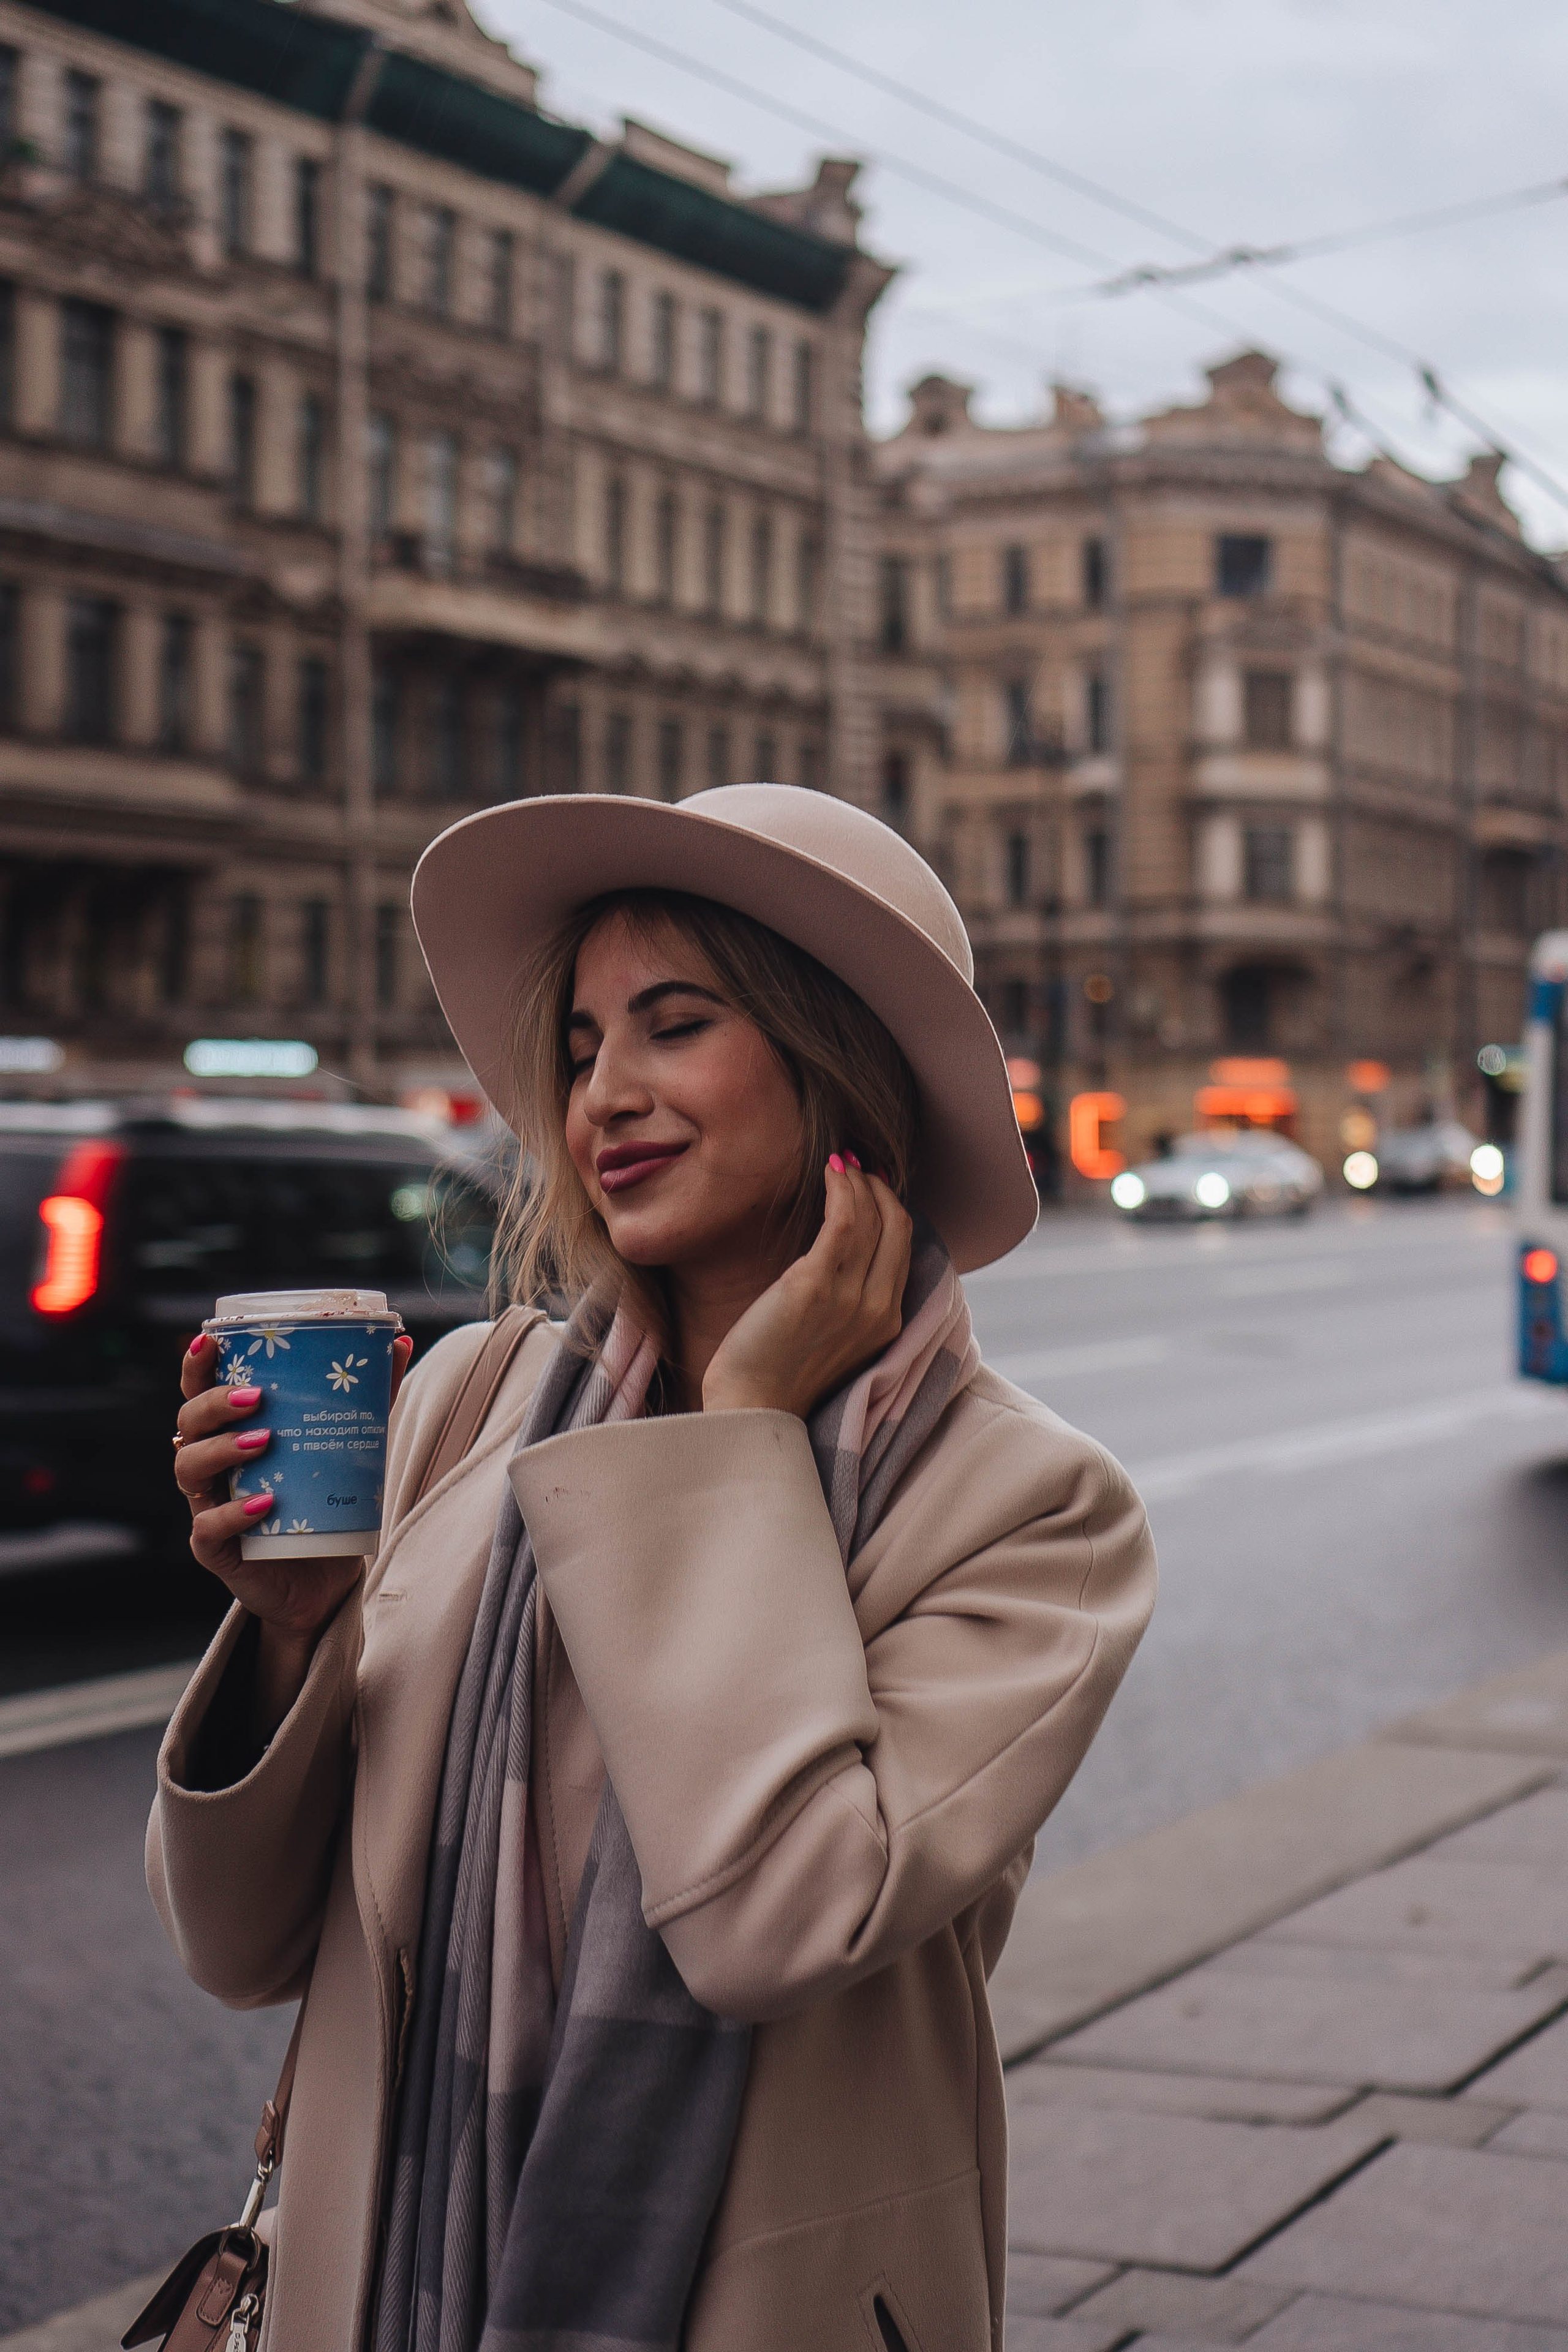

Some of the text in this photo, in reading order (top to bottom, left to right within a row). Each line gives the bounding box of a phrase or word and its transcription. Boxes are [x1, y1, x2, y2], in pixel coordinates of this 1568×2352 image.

[303, 1410, 374, 1422] выбирай то,
[277, 1428, 301, 1437] что
[306, 1427, 359, 1436] находит
[304, 1439, 344, 1450] твоём
[347, 1440, 380, 1450] сердце
[326, 1492, 357, 1508] буше
